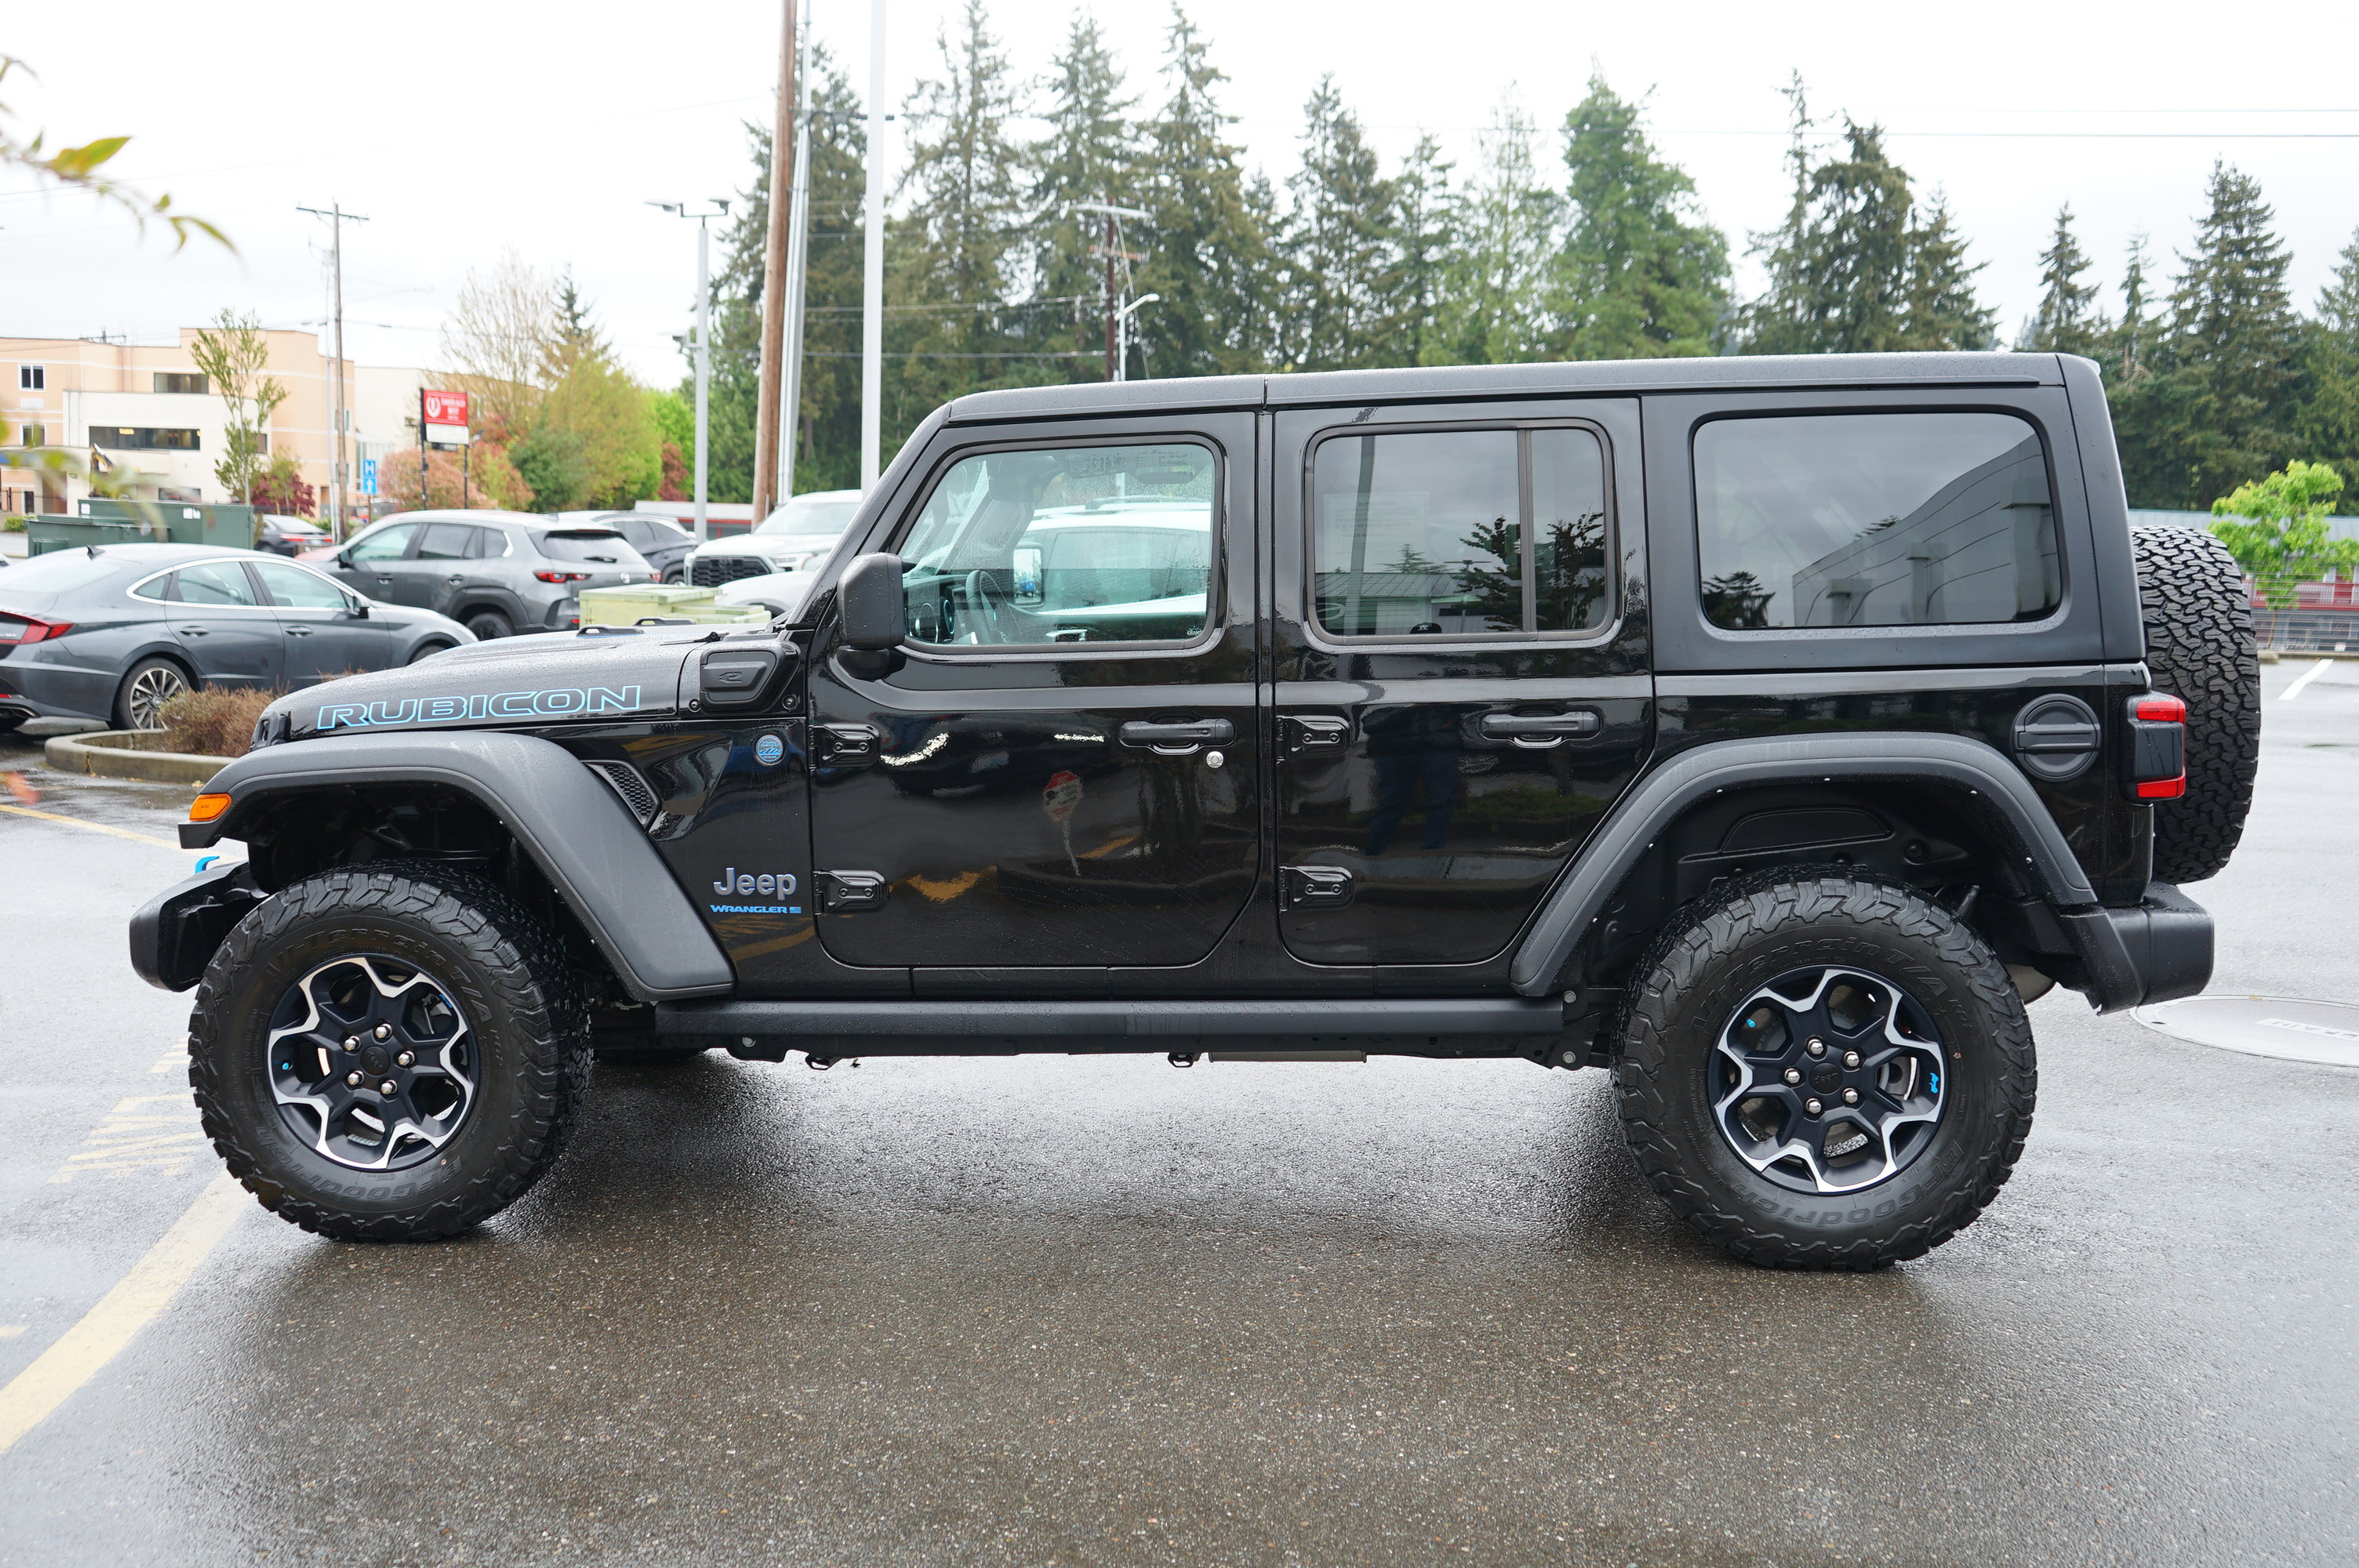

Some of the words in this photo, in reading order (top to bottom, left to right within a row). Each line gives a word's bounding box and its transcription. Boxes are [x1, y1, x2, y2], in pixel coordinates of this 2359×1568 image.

[365, 461, 375, 474] H
[316, 684, 642, 730] RUBICON
[713, 867, 798, 902] Jeep
[710, 904, 788, 914] WRANGLER
[255, 1126, 463, 1201] BFGoodrich
[1731, 1139, 1965, 1228] BFGoodrich
